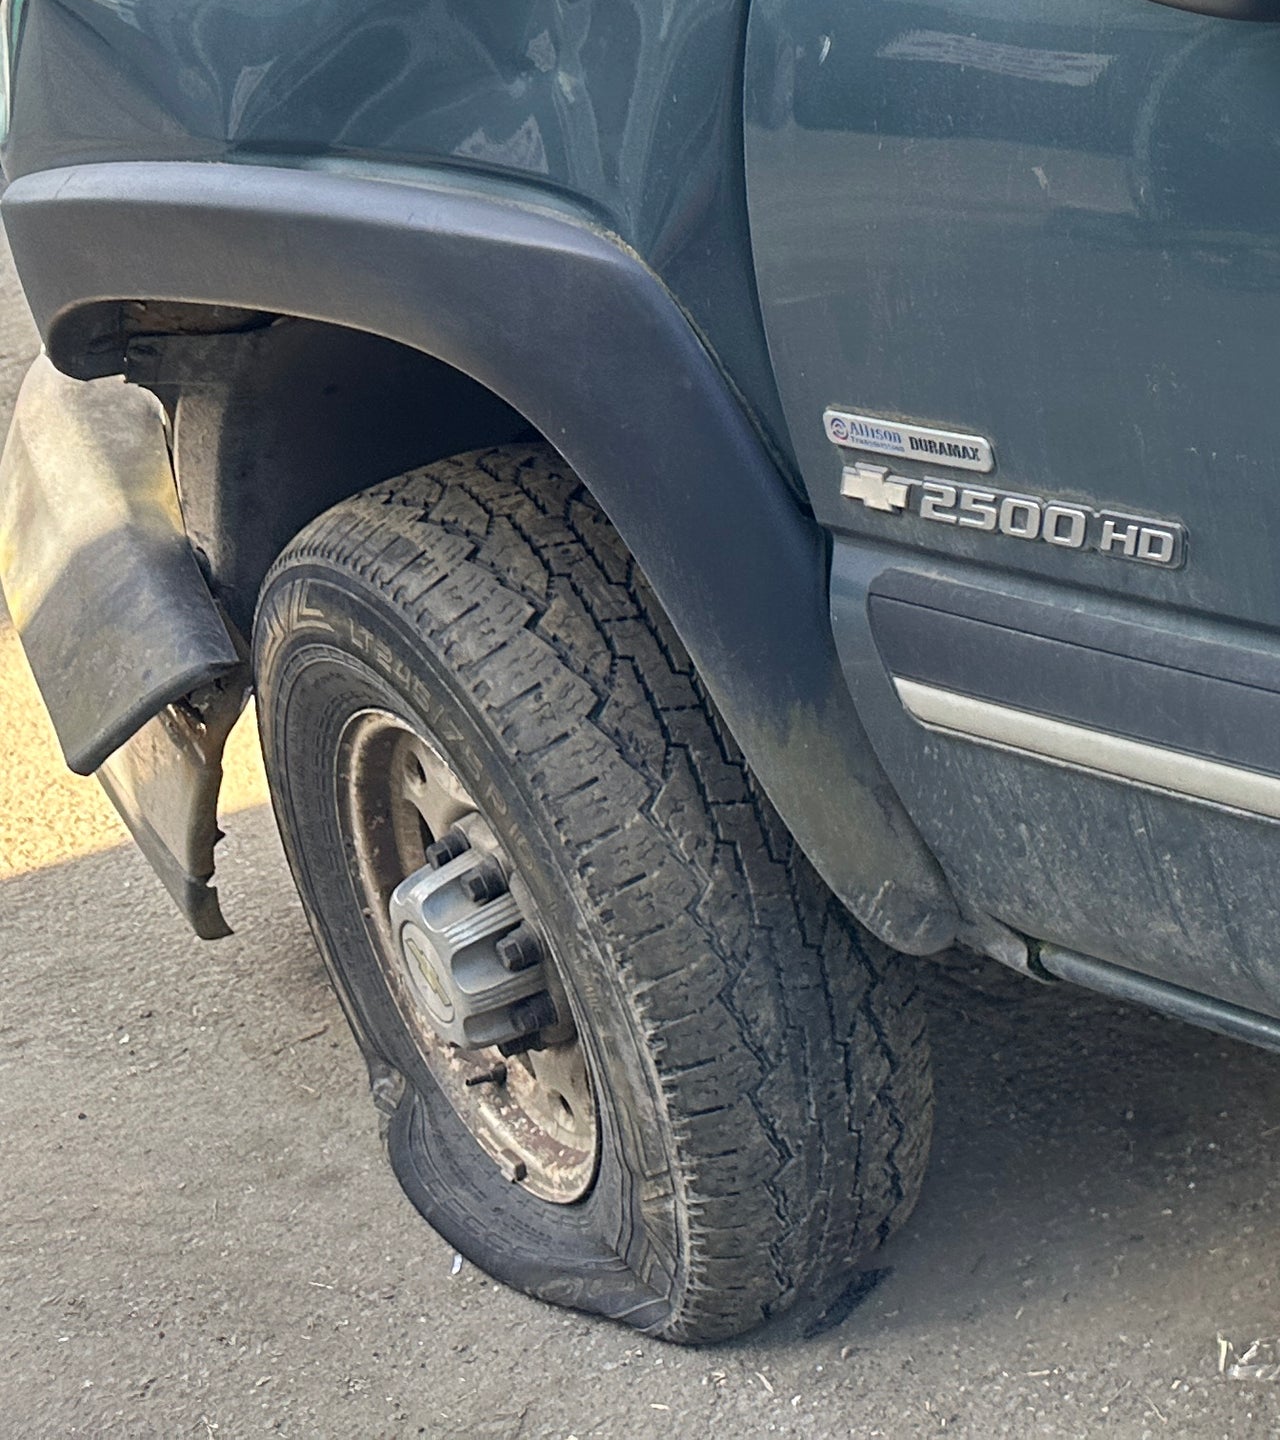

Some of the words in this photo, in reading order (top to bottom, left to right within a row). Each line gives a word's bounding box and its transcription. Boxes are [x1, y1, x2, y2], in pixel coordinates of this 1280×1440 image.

[849, 421, 903, 444] Allison
[908, 436, 981, 462] DURAMAX
[919, 479, 1087, 549] 2500
[1100, 520, 1175, 563] HD
